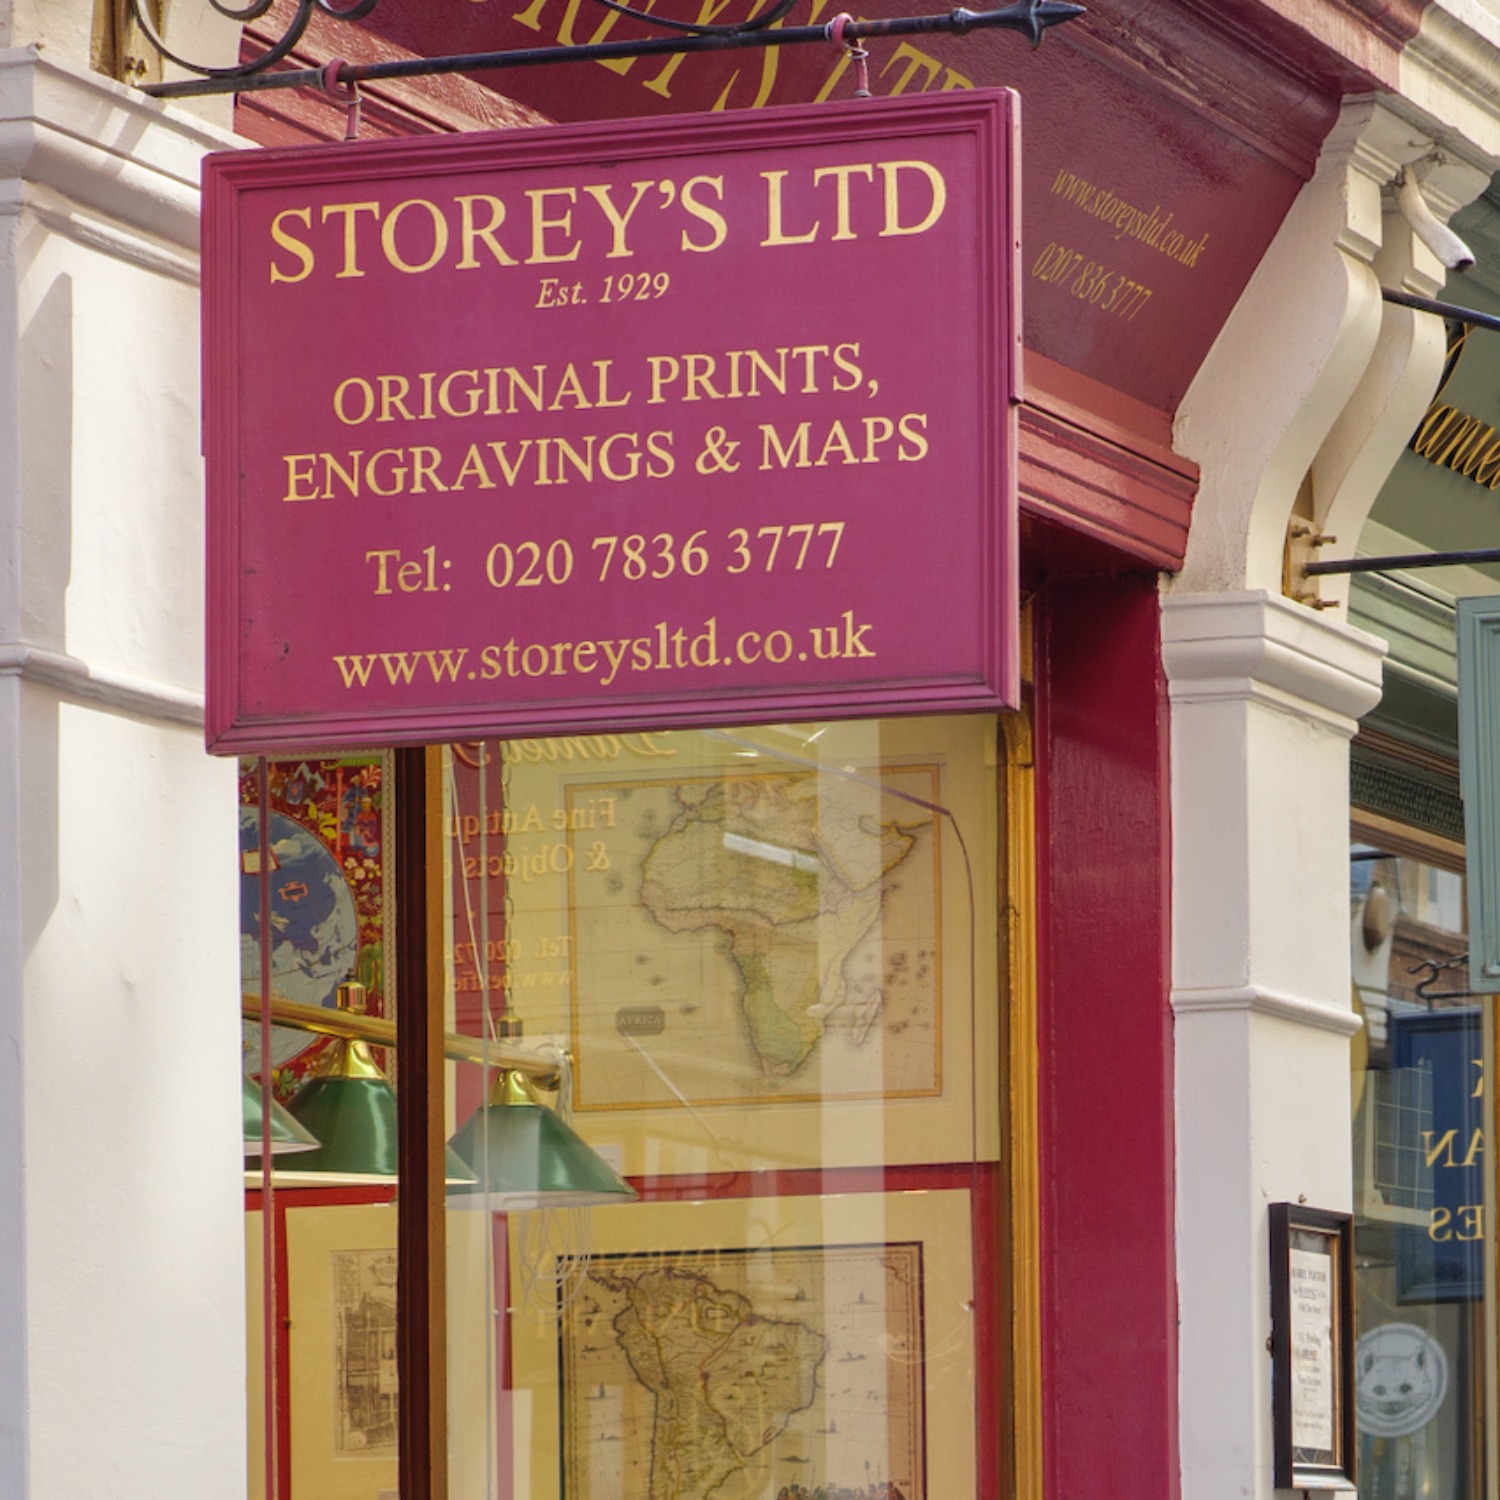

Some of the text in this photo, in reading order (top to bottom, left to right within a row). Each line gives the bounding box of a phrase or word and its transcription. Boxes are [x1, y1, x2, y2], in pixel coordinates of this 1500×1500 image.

[271, 161, 946, 283] STOREY'S LTD
[1052, 169, 1210, 268] www.storeysltd.co.uk
[535, 272, 669, 308] Est. 1929
[1032, 242, 1153, 321] 0207 836 3777
[334, 343, 878, 424] ORIGINAL PRINTS,
[283, 414, 928, 501] ENGRAVINGS & MAPS
[366, 522, 844, 594] Tel: 020 7836 3777
[333, 610, 876, 688] www.storeysltd.co.uk
